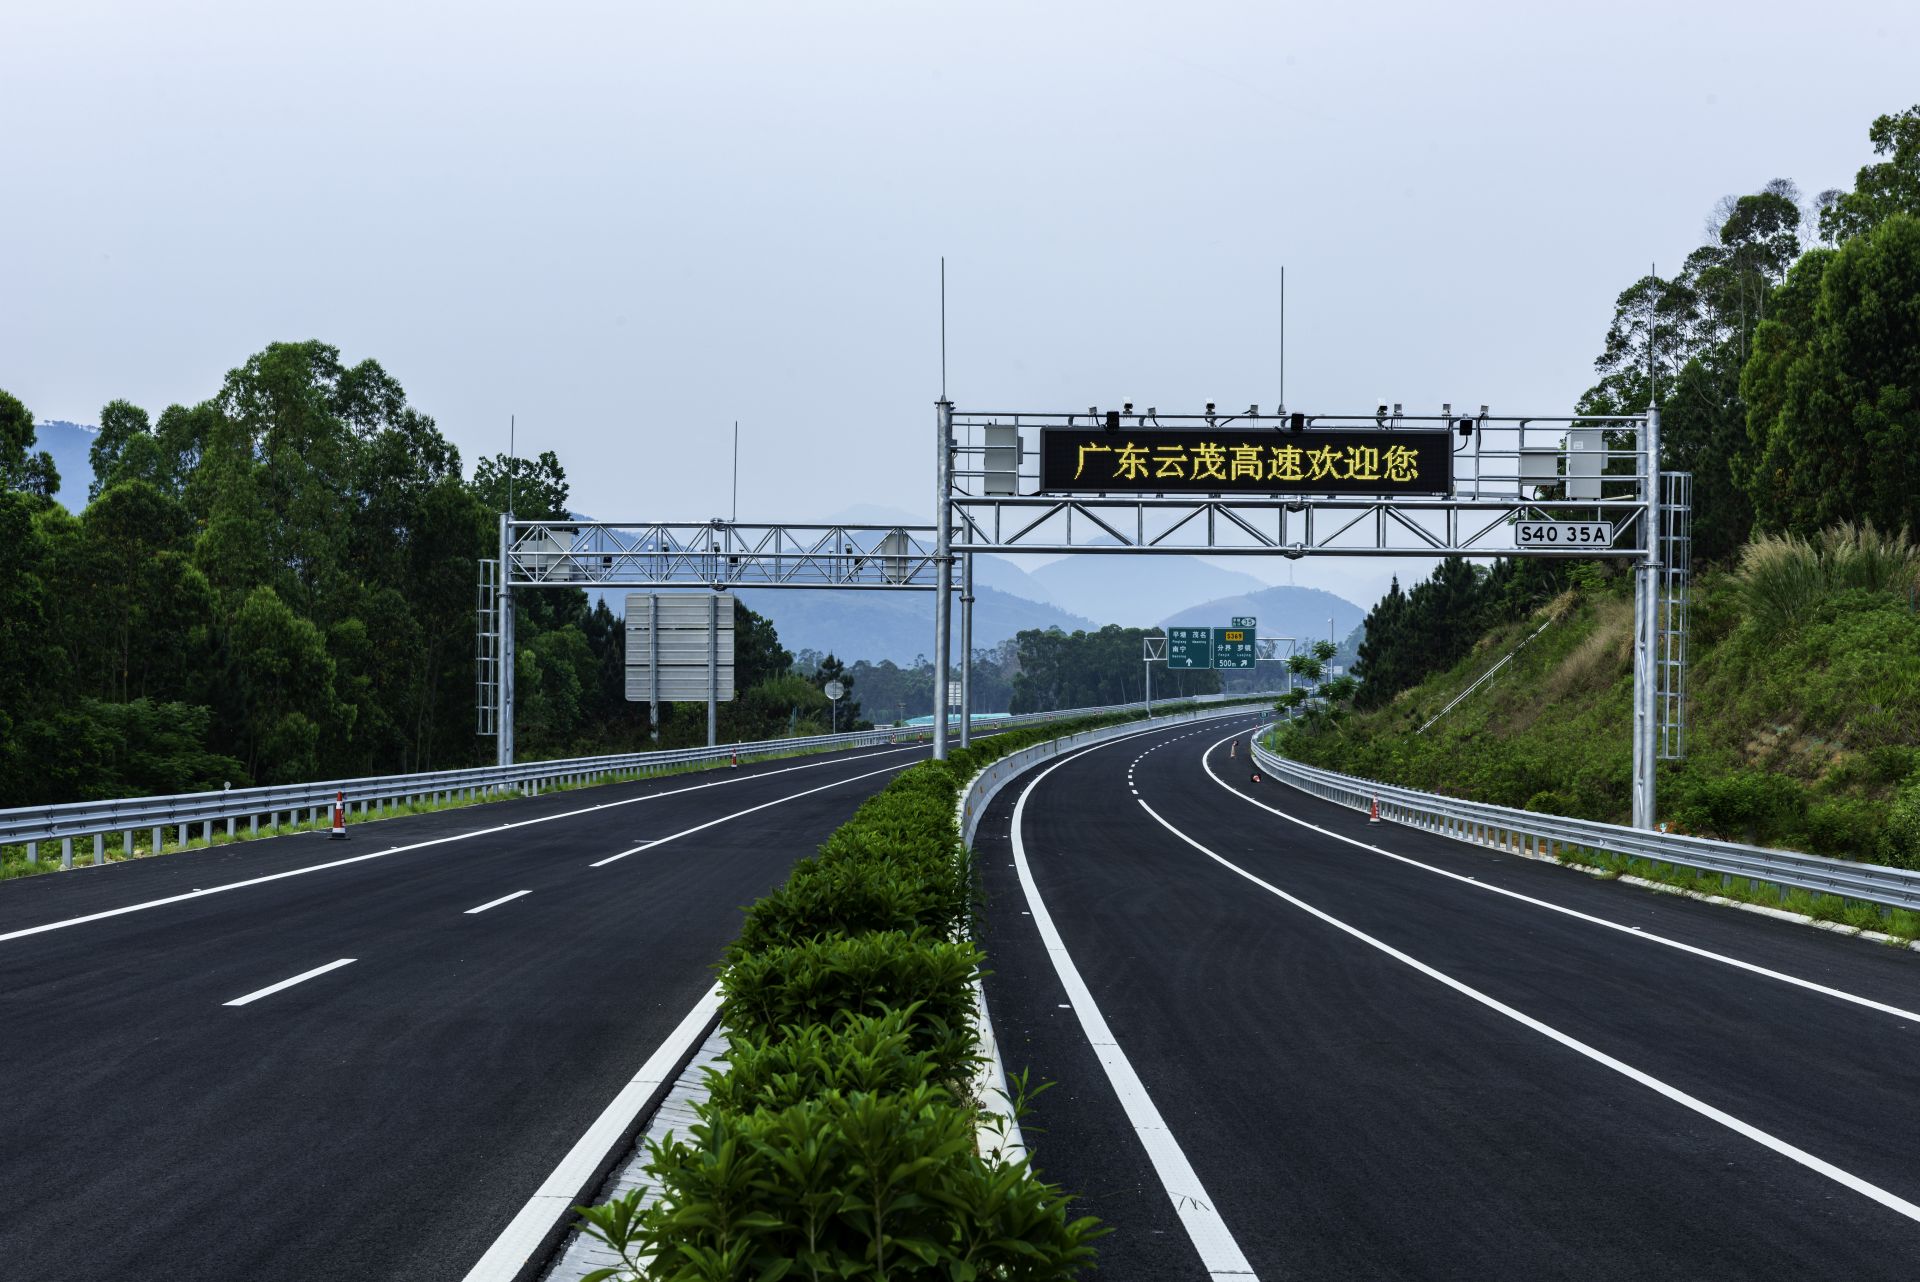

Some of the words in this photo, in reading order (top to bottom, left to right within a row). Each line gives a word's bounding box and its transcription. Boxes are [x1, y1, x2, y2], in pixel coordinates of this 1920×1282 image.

[1074, 442, 1419, 482] 广东云茂高速欢迎您
[1521, 526, 1558, 542] S40
[1566, 526, 1606, 542] 35A
[1192, 631, 1207, 639] 茂名
[1217, 644, 1232, 652] 分界
[1219, 659, 1237, 667] 500m
